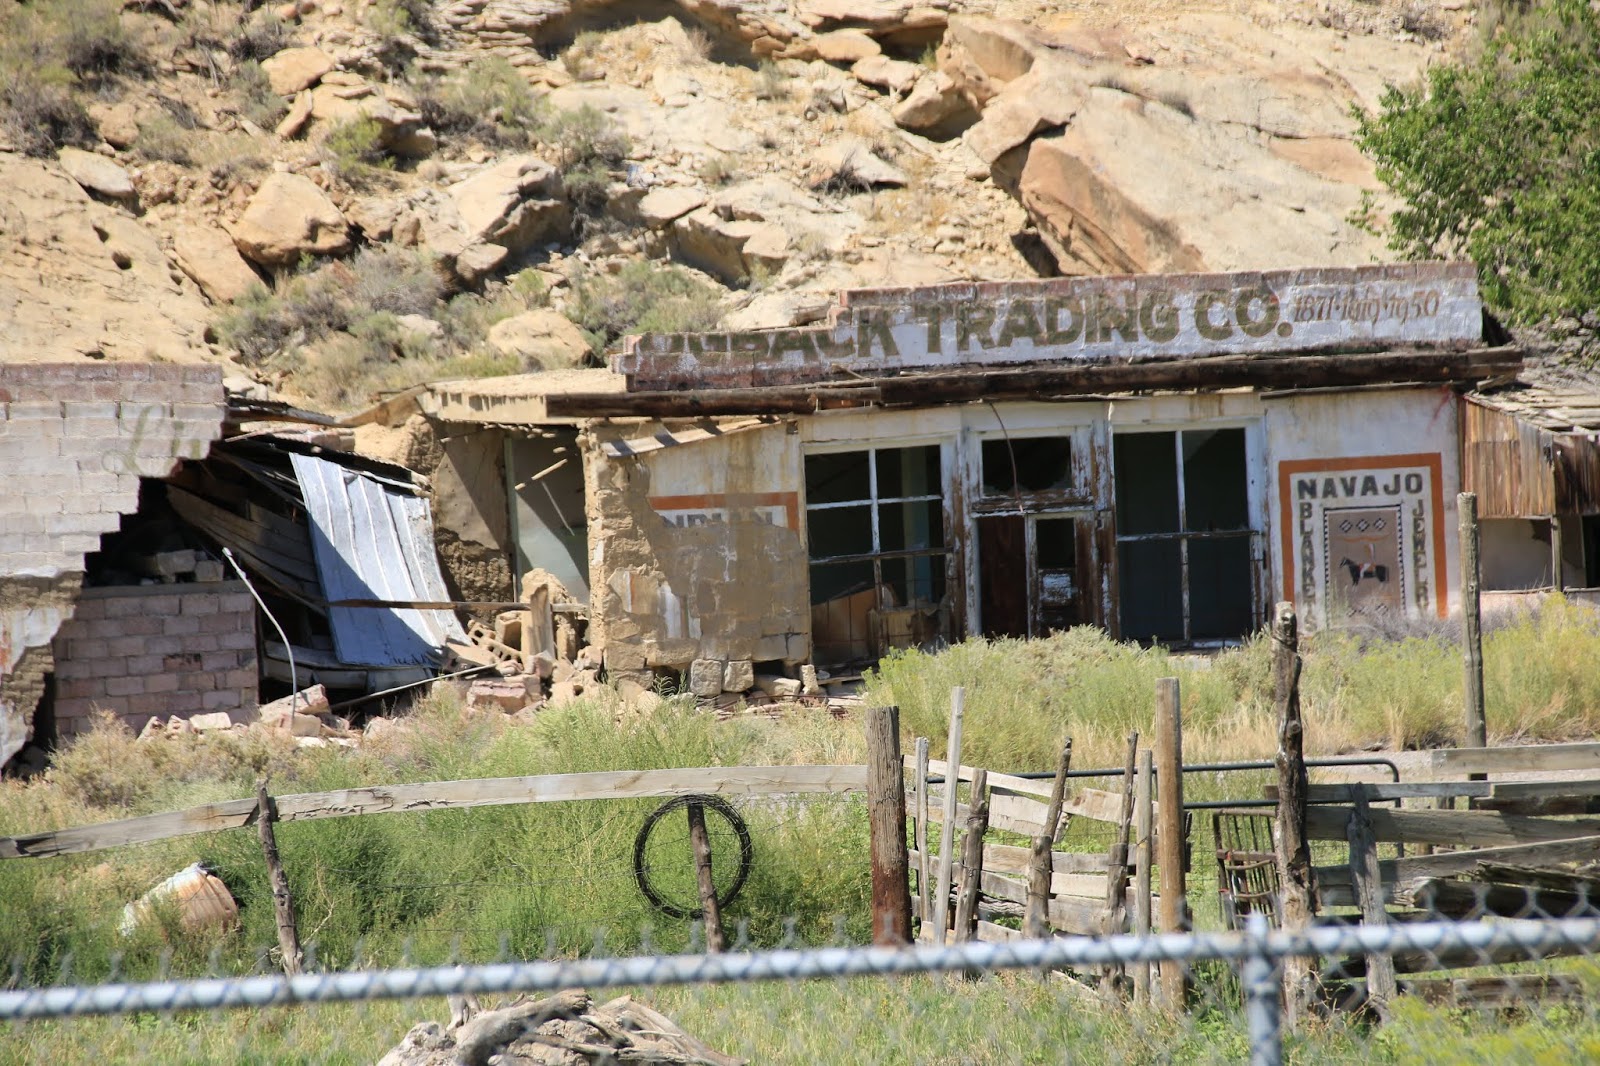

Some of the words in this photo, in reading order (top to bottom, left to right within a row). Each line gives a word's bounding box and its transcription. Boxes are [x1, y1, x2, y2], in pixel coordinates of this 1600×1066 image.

[913, 289, 1182, 354] TRADING
[1194, 288, 1294, 339] CO.
[1297, 473, 1424, 500] NAVAJO
